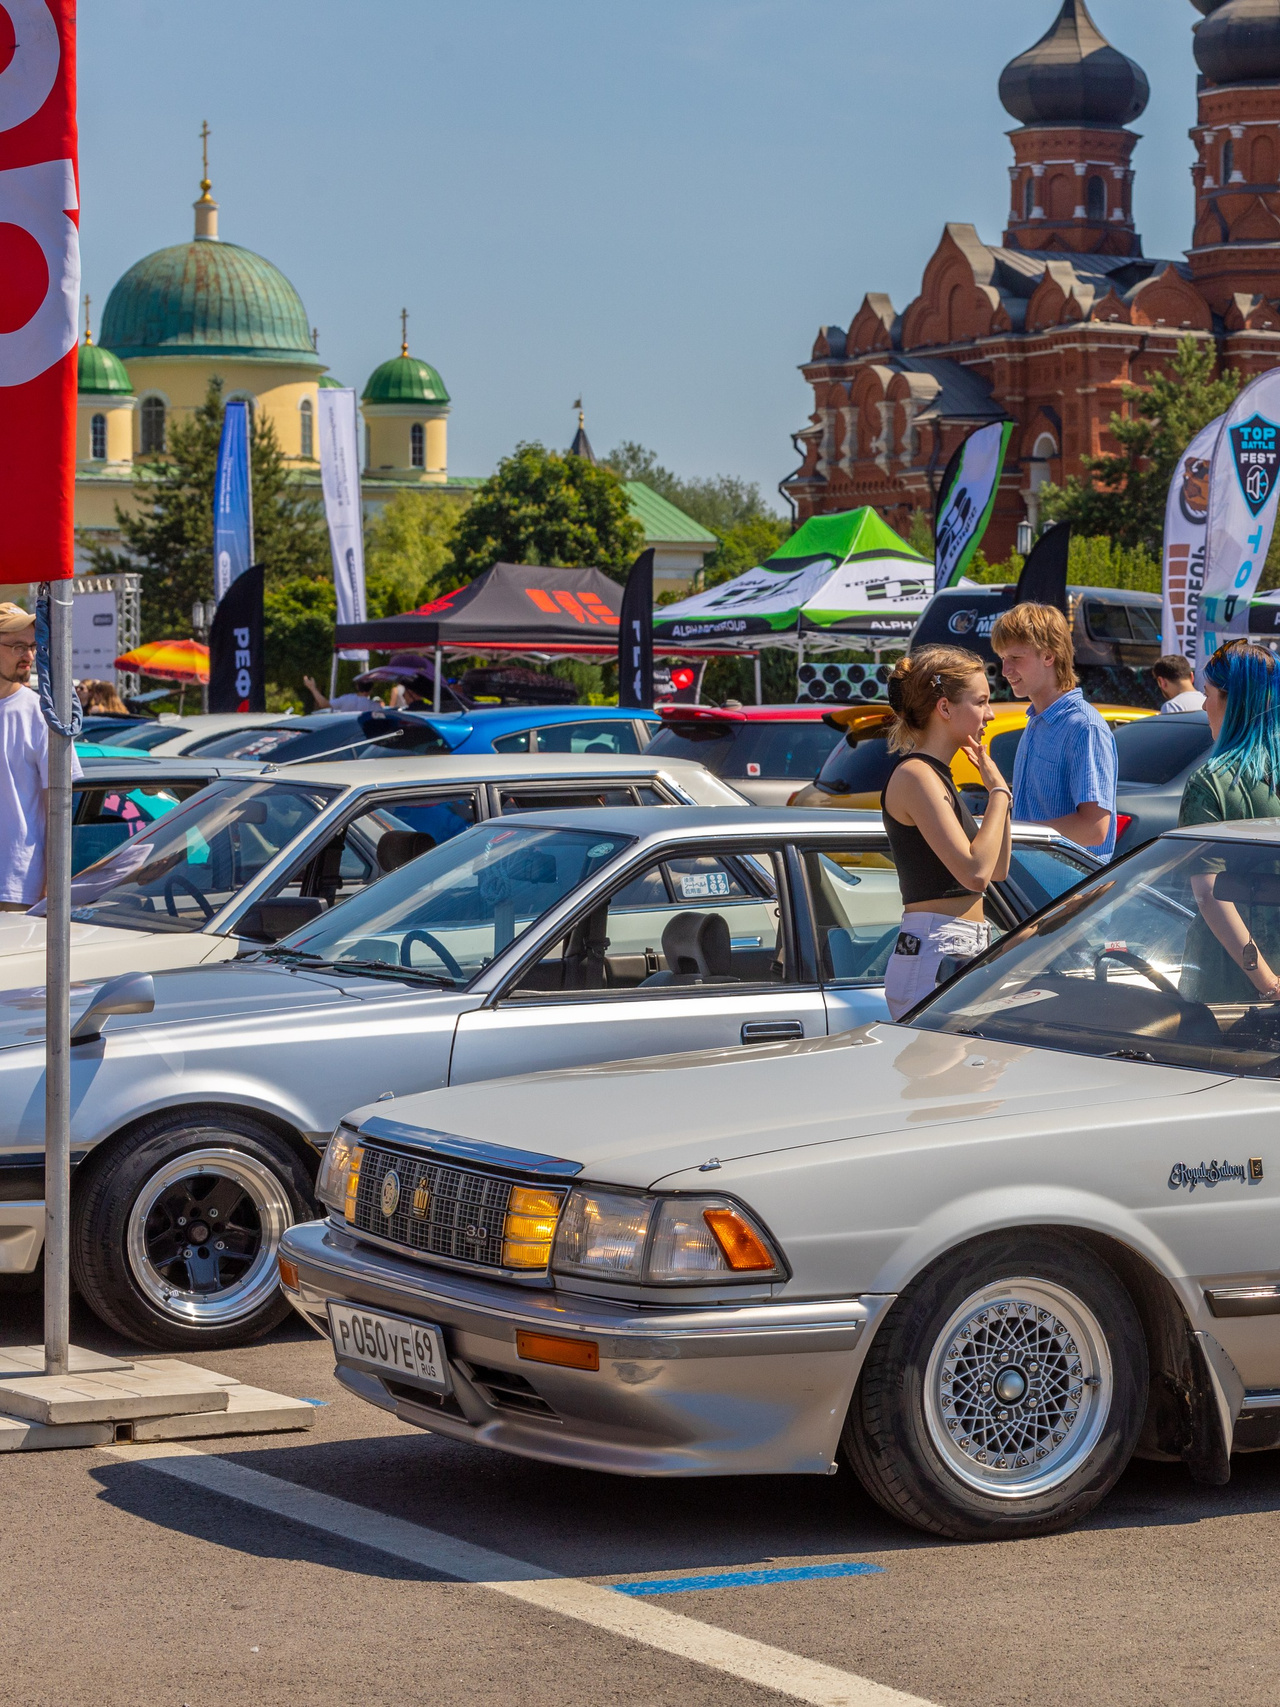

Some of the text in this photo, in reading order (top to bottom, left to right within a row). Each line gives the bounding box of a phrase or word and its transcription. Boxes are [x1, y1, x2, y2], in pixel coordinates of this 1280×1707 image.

[1239, 427, 1277, 440] TOP
[1241, 441, 1276, 450] BATTLE
[1240, 453, 1277, 464] FEST
[870, 621, 917, 630] ALPH
[233, 626, 251, 698] РЕФ
[1169, 1161, 1208, 1187] Royal
[1204, 1158, 1247, 1182] Saloon
[466, 1224, 487, 1239] 3.0
[415, 1330, 433, 1363] 69
[420, 1363, 436, 1377] RUS
